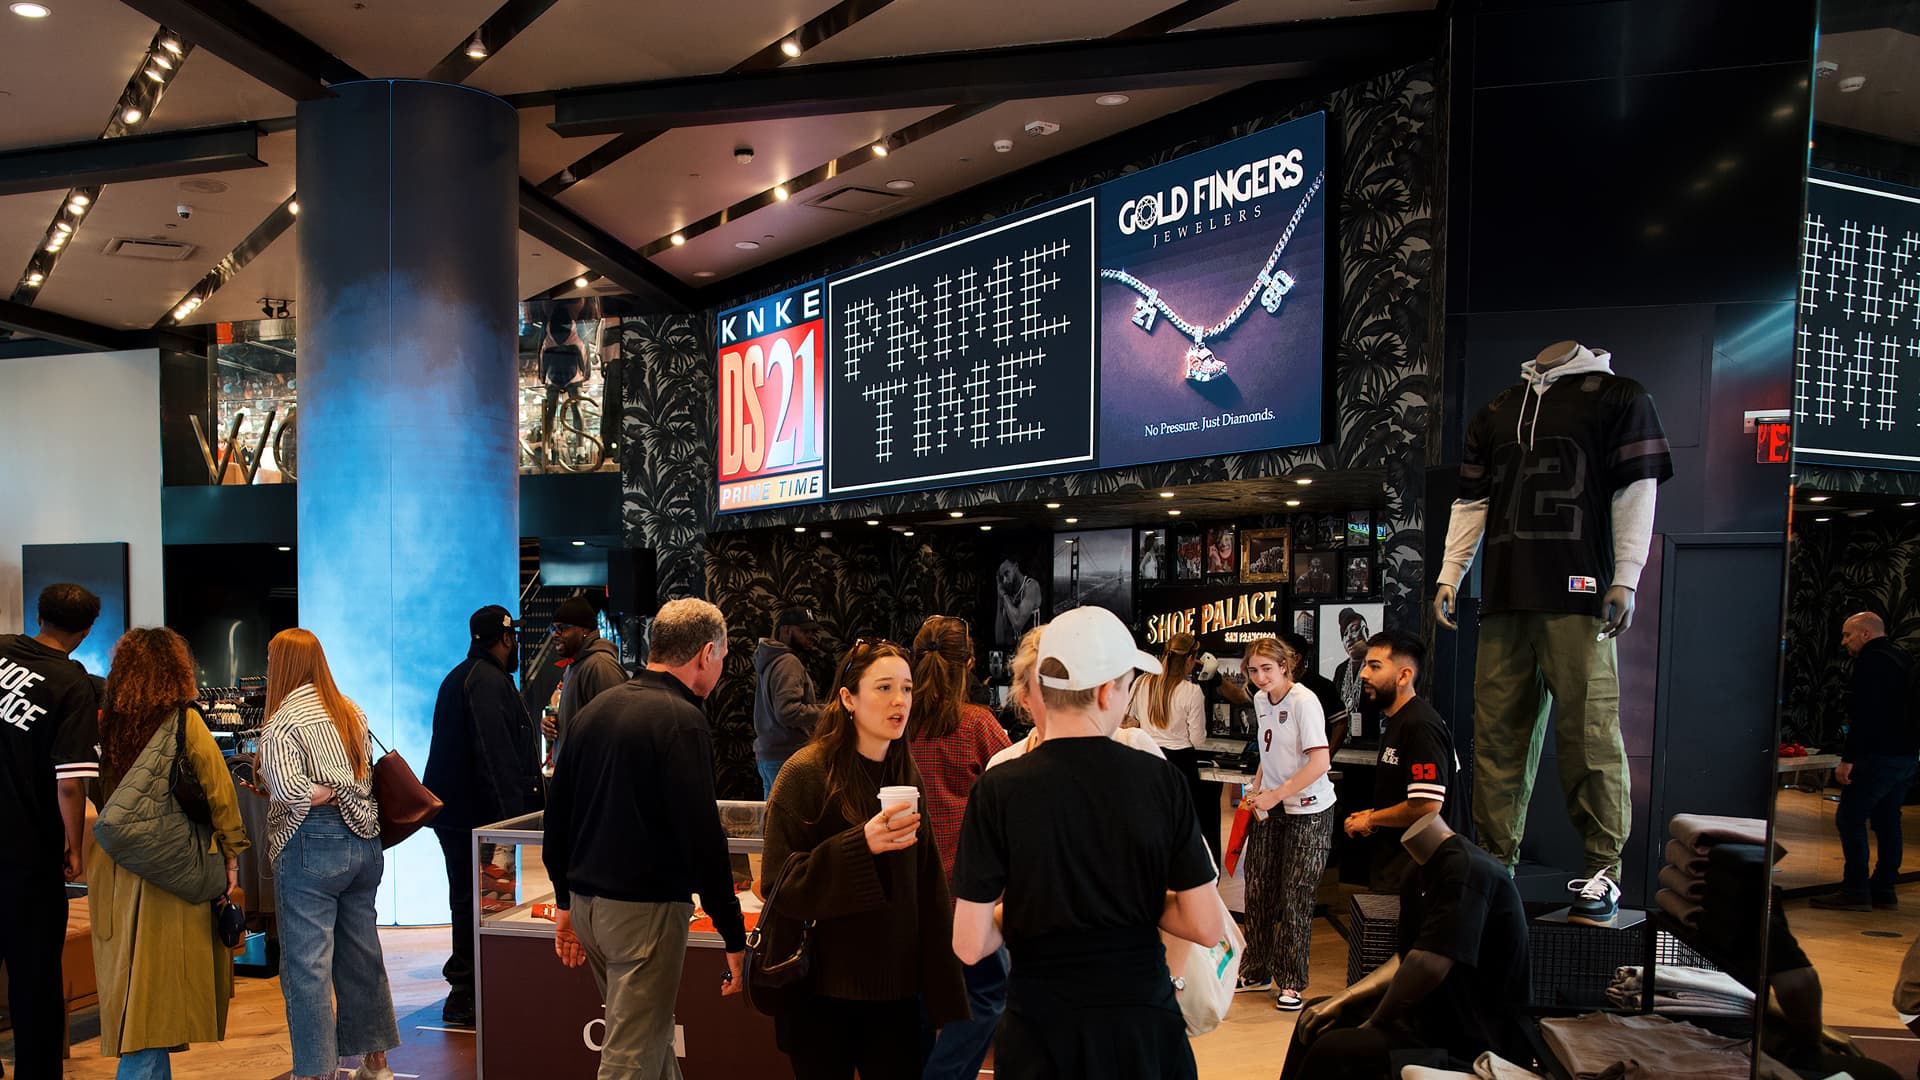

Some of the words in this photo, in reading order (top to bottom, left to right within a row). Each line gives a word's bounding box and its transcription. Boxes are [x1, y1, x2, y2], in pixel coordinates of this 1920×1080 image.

[1118, 186, 1189, 235] GOLD
[1193, 148, 1304, 216] FINGERS
[1153, 205, 1263, 248] JEWELERS
[721, 288, 820, 344] KNKE
[844, 238, 1071, 383] PRIME
[722, 328, 822, 476] DS21
[862, 347, 1046, 464] TIME
[1144, 424, 1159, 437] No
[1160, 419, 1200, 435] Pressure.
[1201, 416, 1220, 431] Just
[1222, 407, 1276, 426] Diamonds.
[722, 482, 772, 505] PRIME
[779, 475, 820, 498] TIME
[1147, 607, 1196, 644] SHOE
[1201, 590, 1277, 634] PALACE
[1224, 631, 1238, 643] SAN
[0, 657, 46, 698] HOE
[1264, 728, 1273, 752] 9
[1411, 763, 1437, 781] 93
